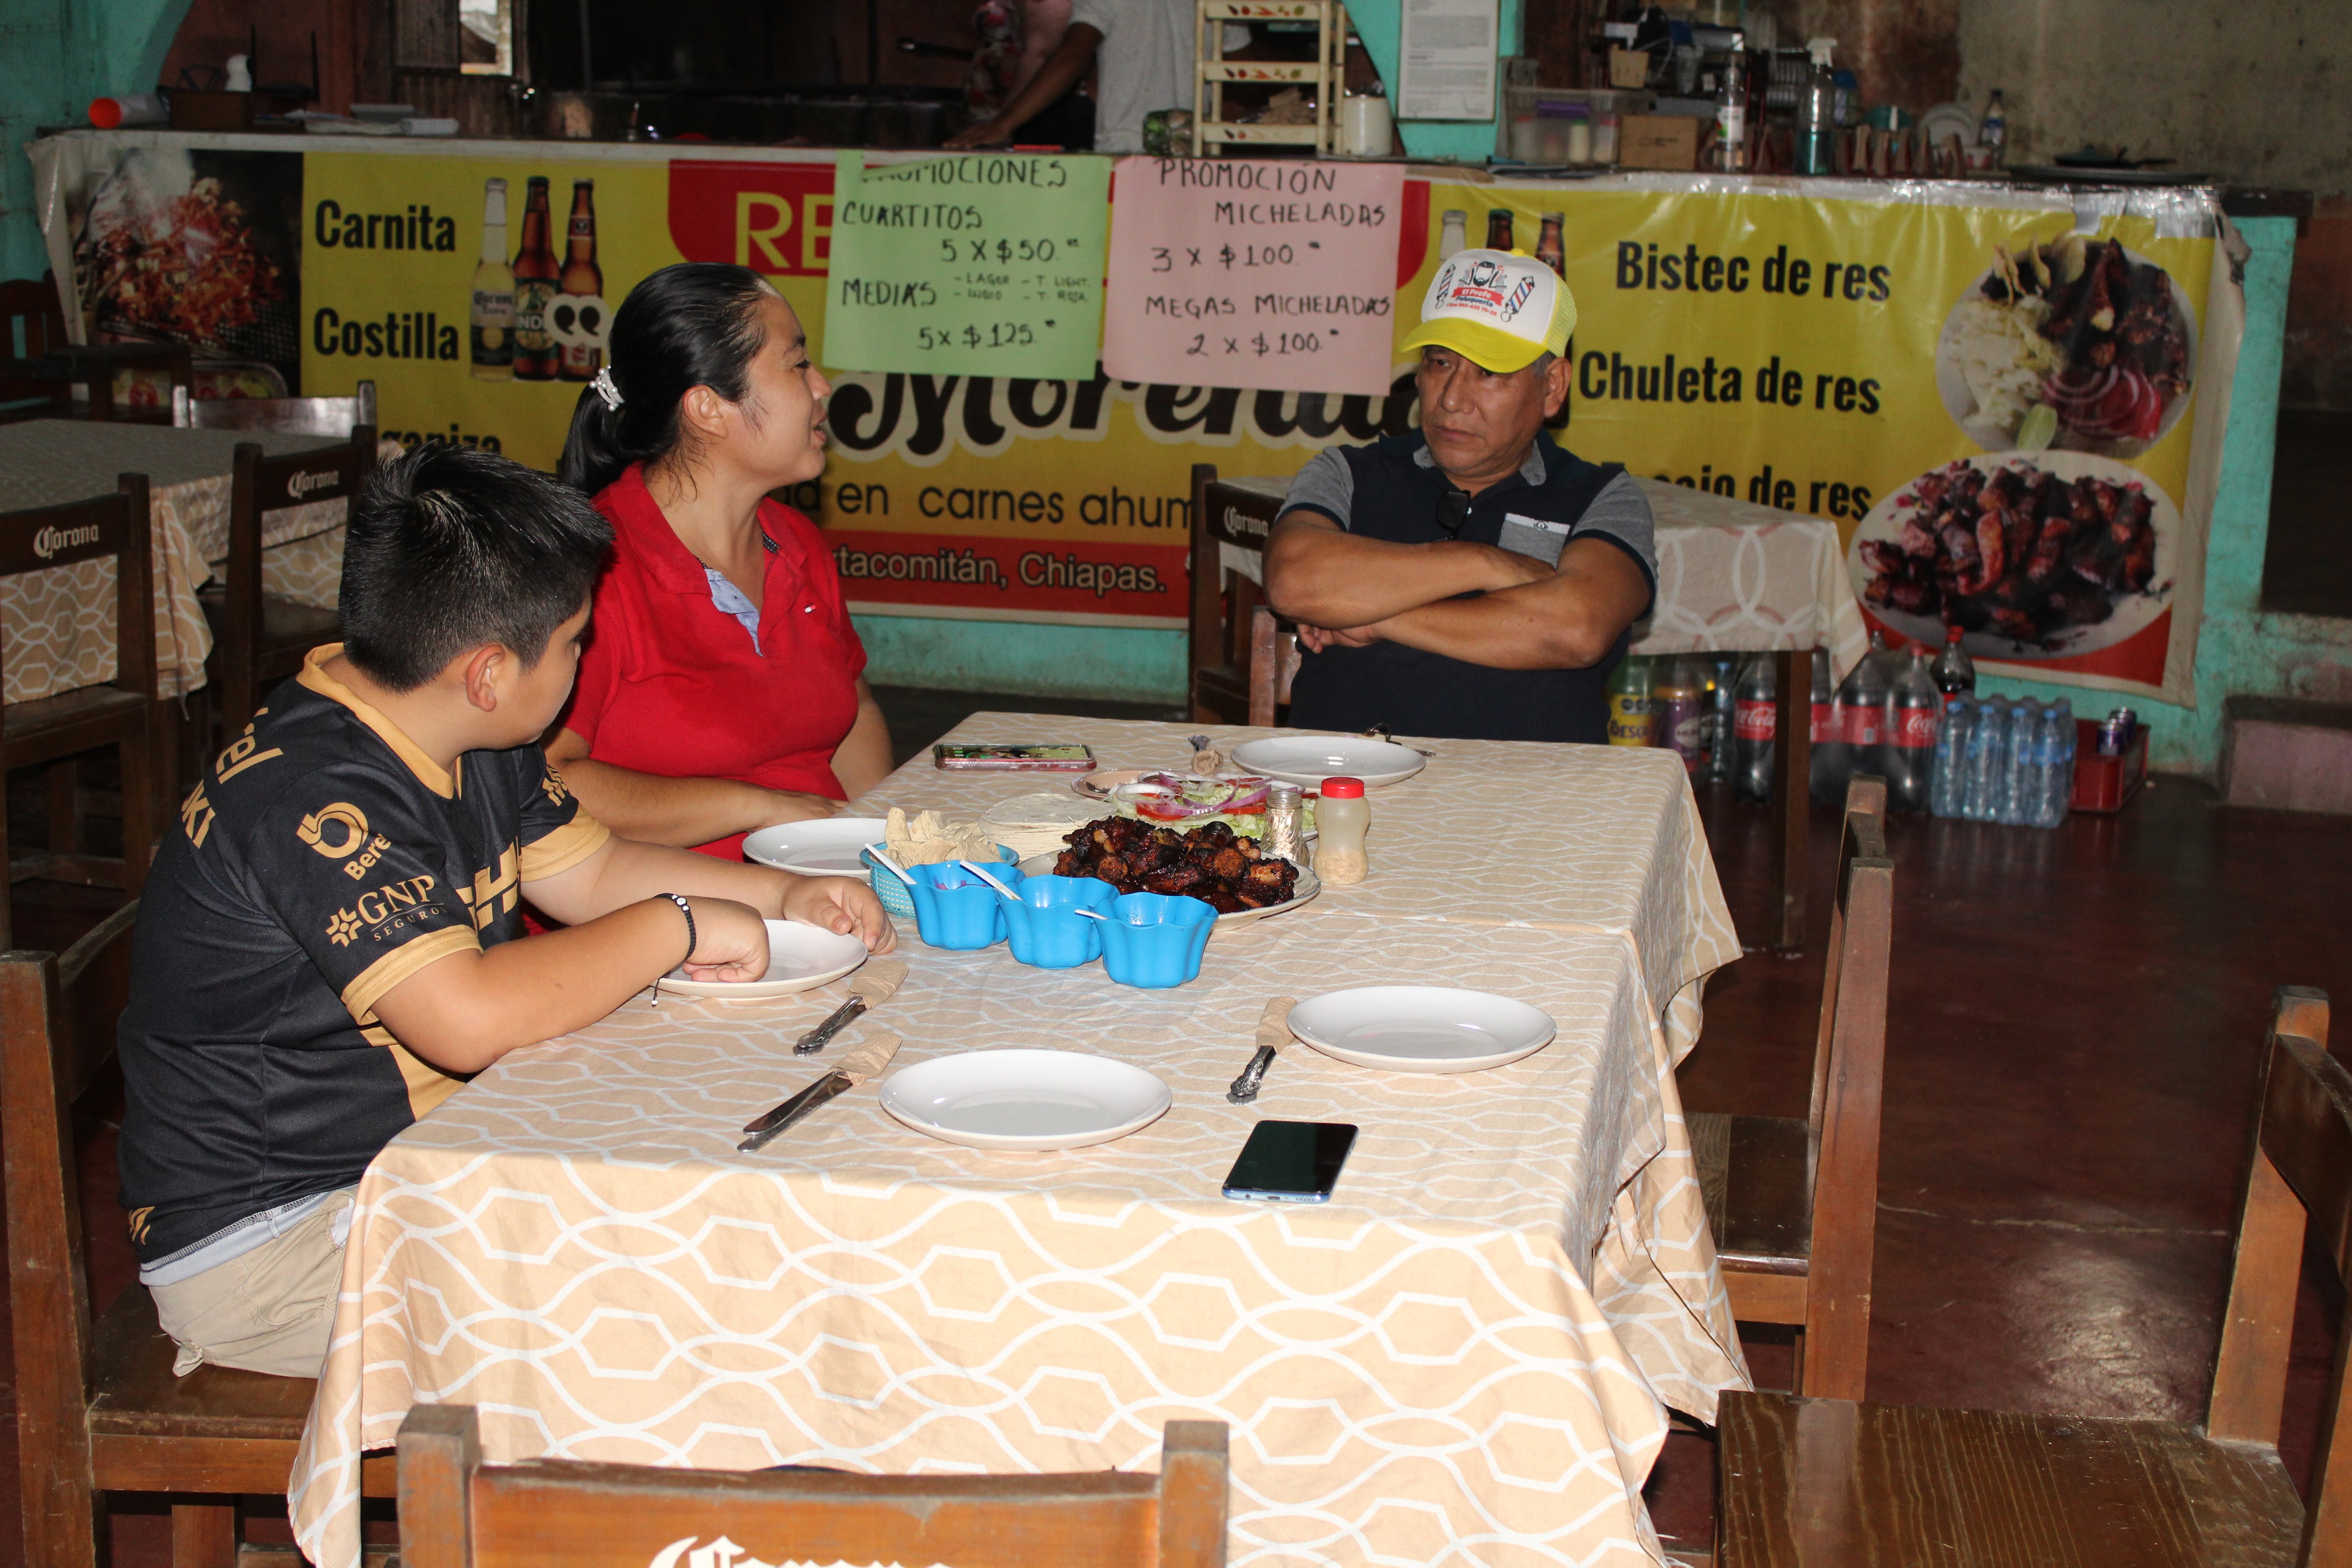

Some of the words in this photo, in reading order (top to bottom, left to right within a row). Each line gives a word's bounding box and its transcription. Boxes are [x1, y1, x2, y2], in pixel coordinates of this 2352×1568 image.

[315, 199, 456, 252] Carnita
[842, 200, 982, 230] CUARTITOS
[1215, 201, 1385, 227] MICHELADAS
[940, 239, 957, 262] 5
[1151, 246, 1173, 272] 3
[1617, 241, 1750, 293] Bistec
[1762, 245, 1812, 296] de
[1824, 262, 1891, 302] res
[842, 278, 937, 307] MEDIAS
[1146, 296, 1236, 318] MEGAS
[1255, 294, 1391, 317] MICHELADAS
[313, 307, 459, 361] Costilla
[1187, 333, 1210, 357] 2
[1579, 350, 1742, 403] Chuleta
[1756, 356, 1803, 406] de
[1815, 373, 1881, 414] res
[287, 469, 339, 500] Corona
[1749, 466, 1796, 511] de
[1810, 480, 1873, 520] res
[837, 483, 888, 514] en
[919, 486, 1064, 523] carnes
[1223, 505, 1269, 538] Corona
[33, 524, 99, 560] Corona
[832, 539, 1008, 590] tacomitán,
[1019, 551, 1167, 598] Chiapas.
[343, 833, 392, 881] Bere
[358, 875, 435, 924] GNP
